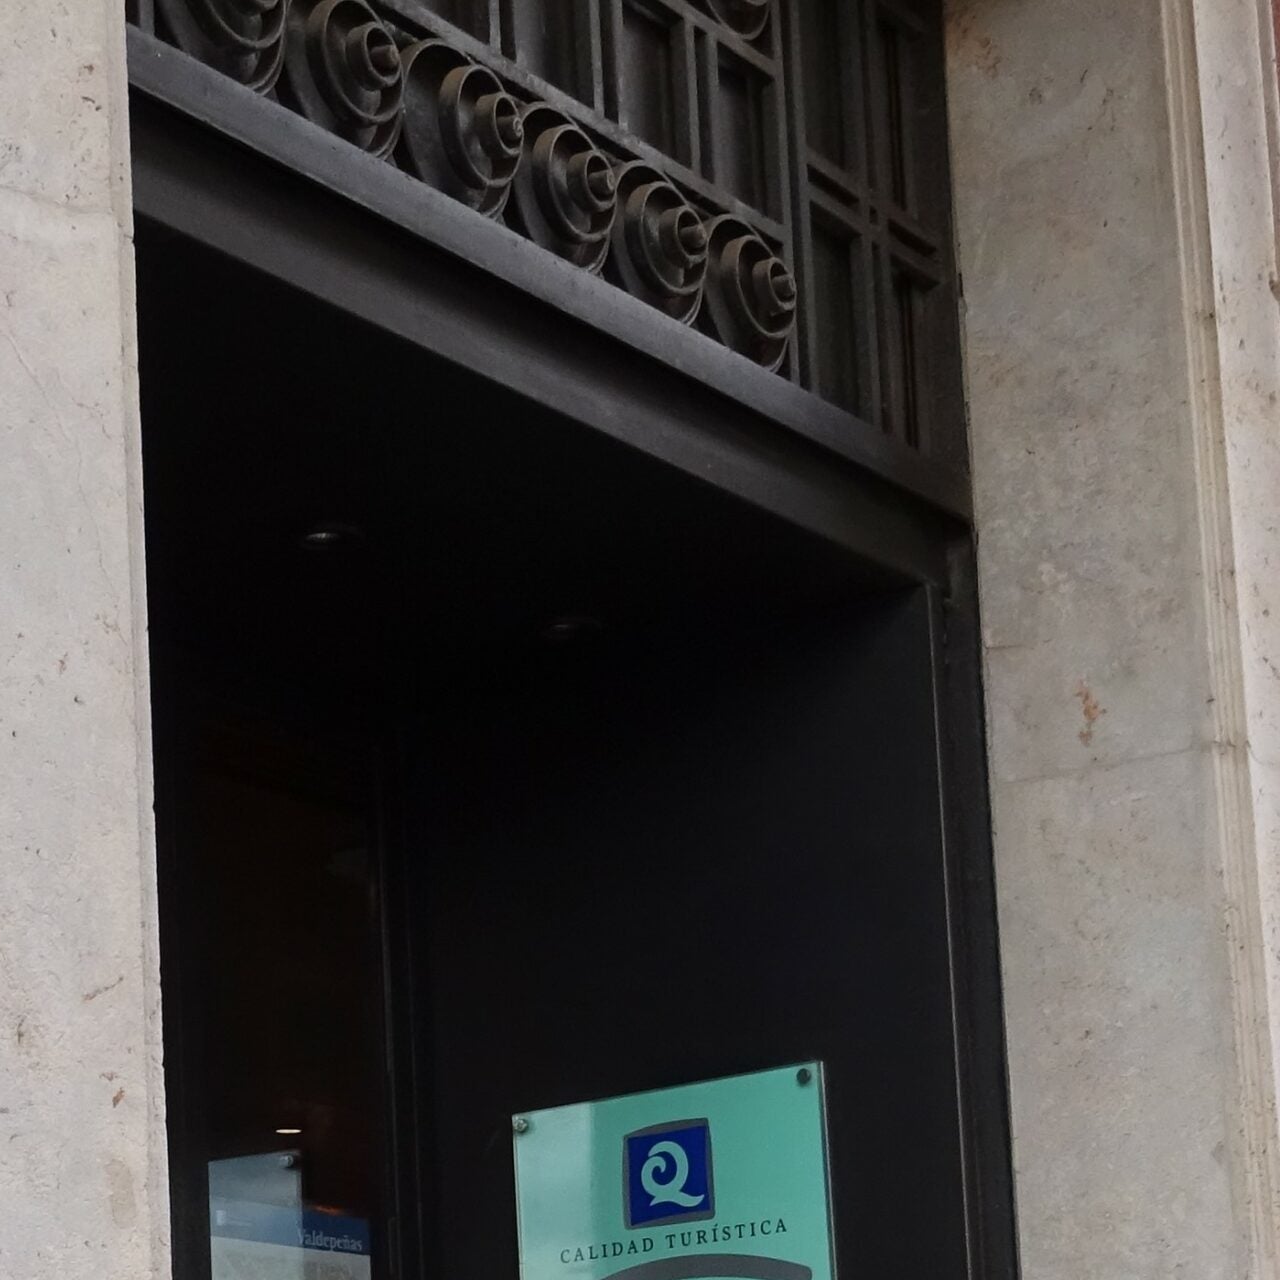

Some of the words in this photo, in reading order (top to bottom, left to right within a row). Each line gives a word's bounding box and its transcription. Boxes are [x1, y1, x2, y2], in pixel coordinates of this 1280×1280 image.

[297, 1228, 363, 1252] Valdepeñas
[560, 1236, 655, 1264] CALIDAD
[665, 1217, 788, 1250] TURÍSTICA
